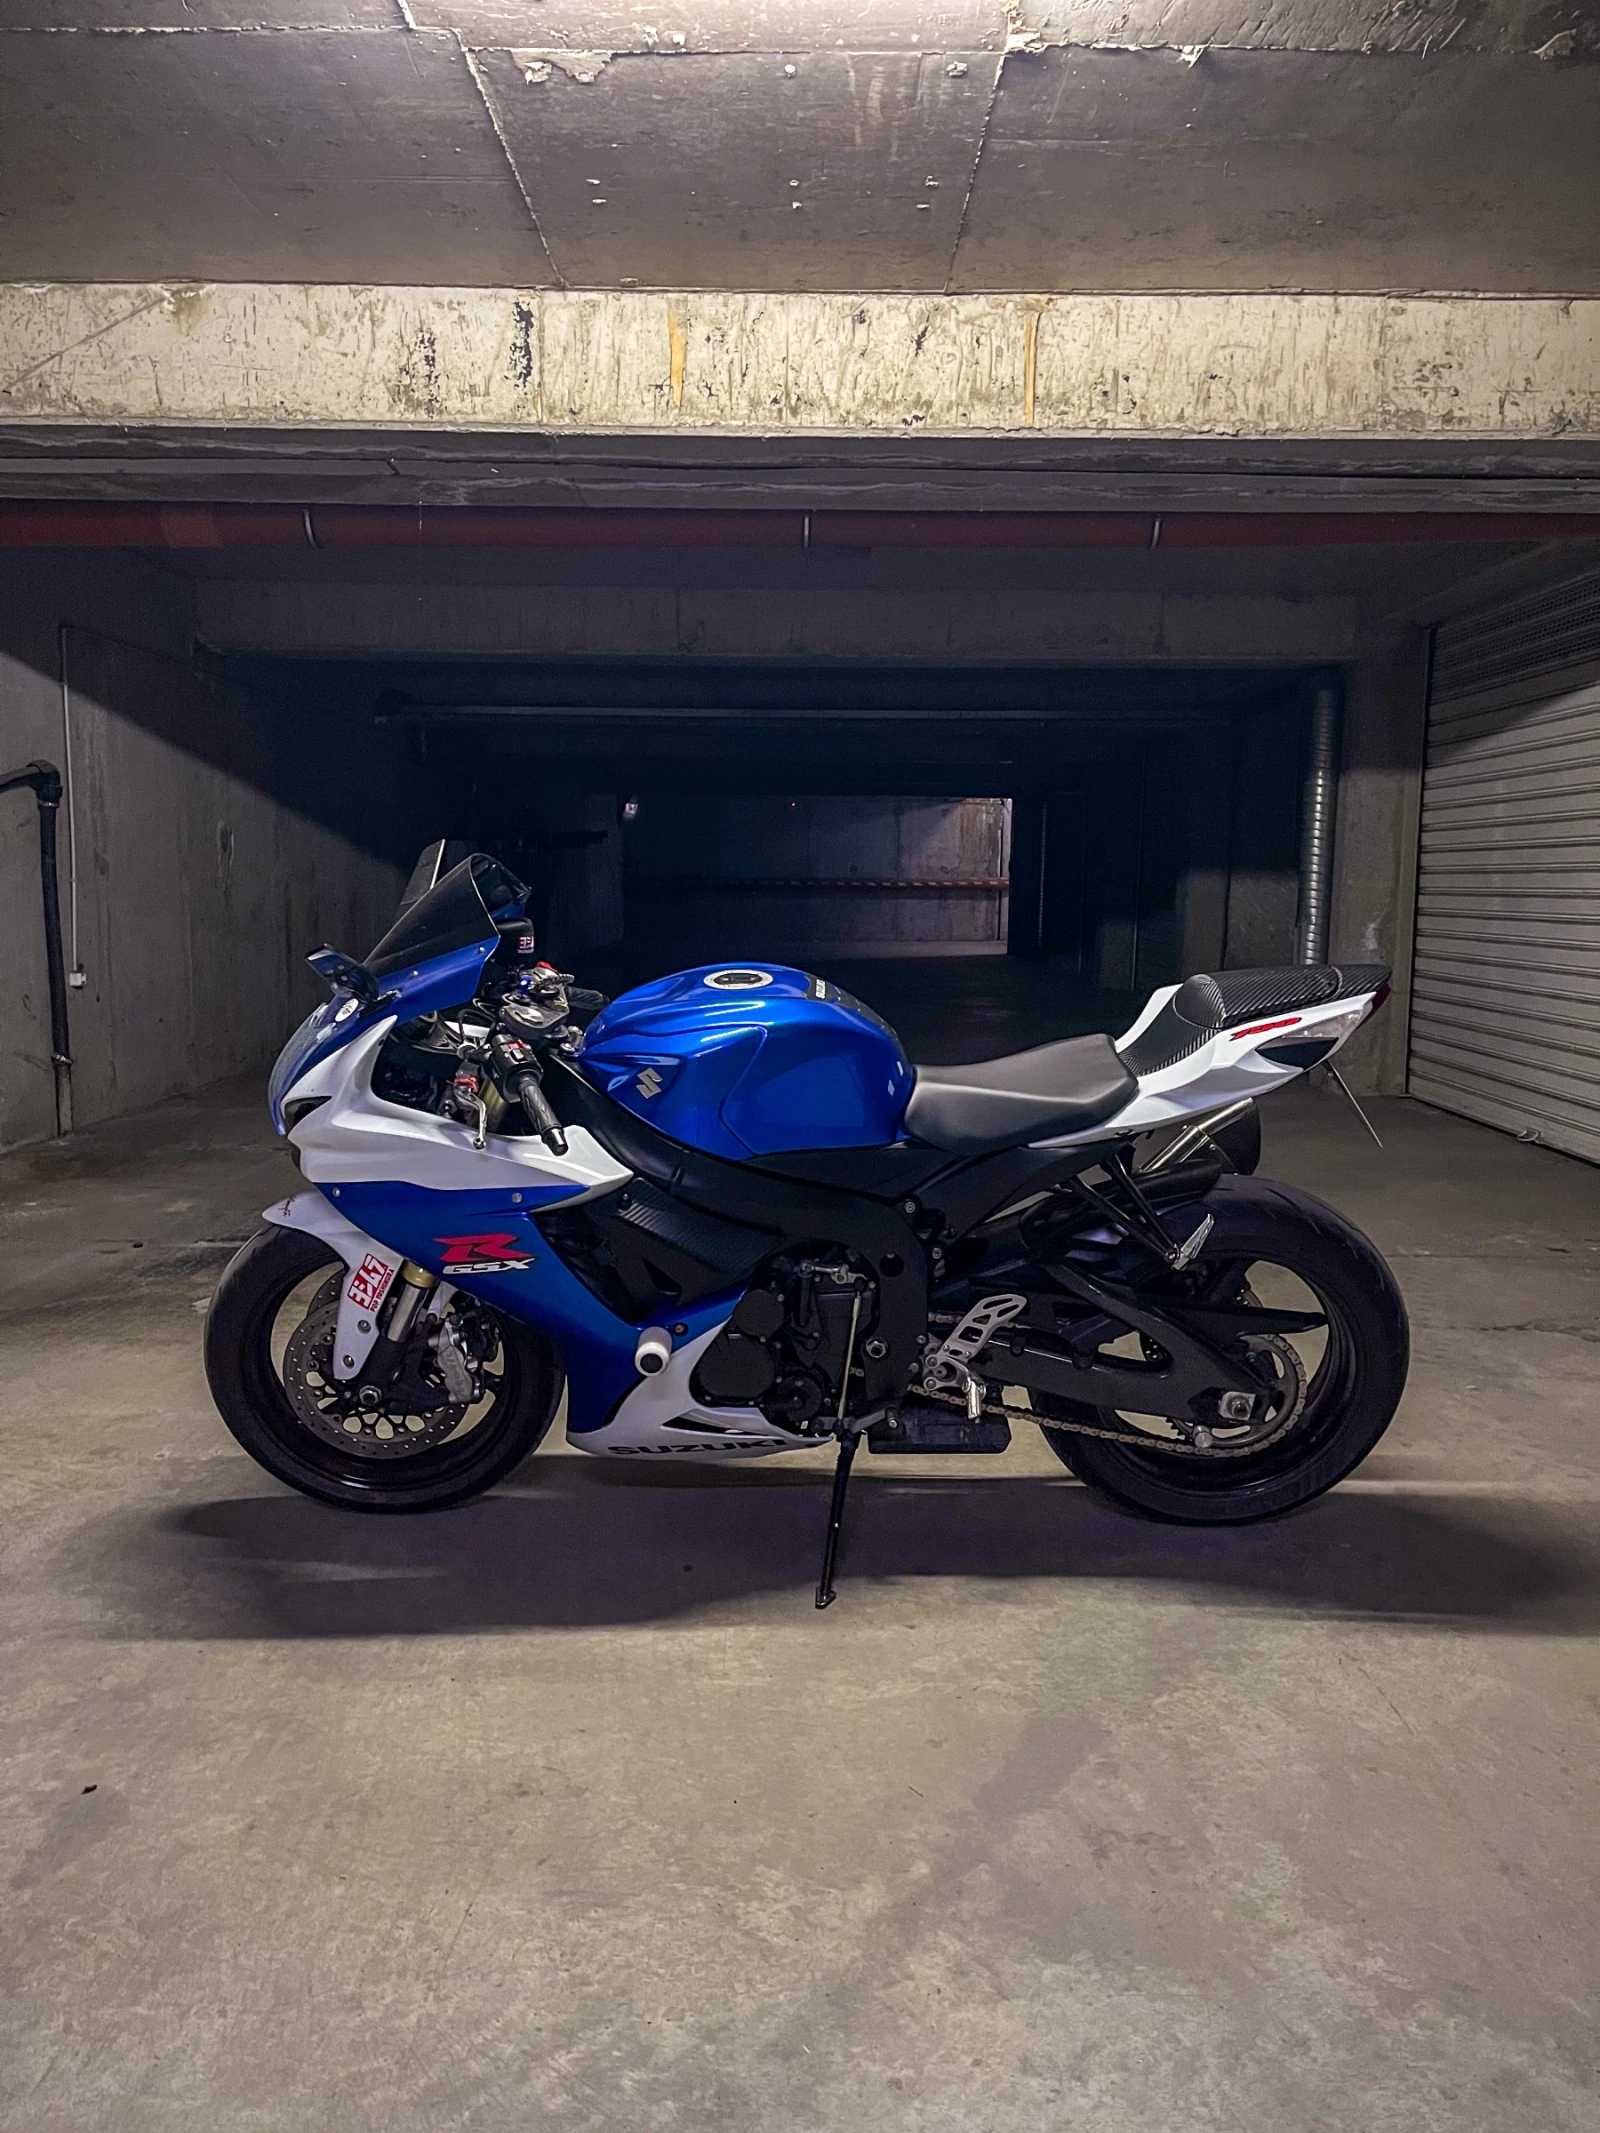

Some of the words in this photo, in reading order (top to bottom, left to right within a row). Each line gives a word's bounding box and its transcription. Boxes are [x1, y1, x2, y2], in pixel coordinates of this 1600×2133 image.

[433, 1233, 537, 1263] R
[442, 1258, 536, 1275] GSX
[607, 1439, 788, 1455] SUZUKI
